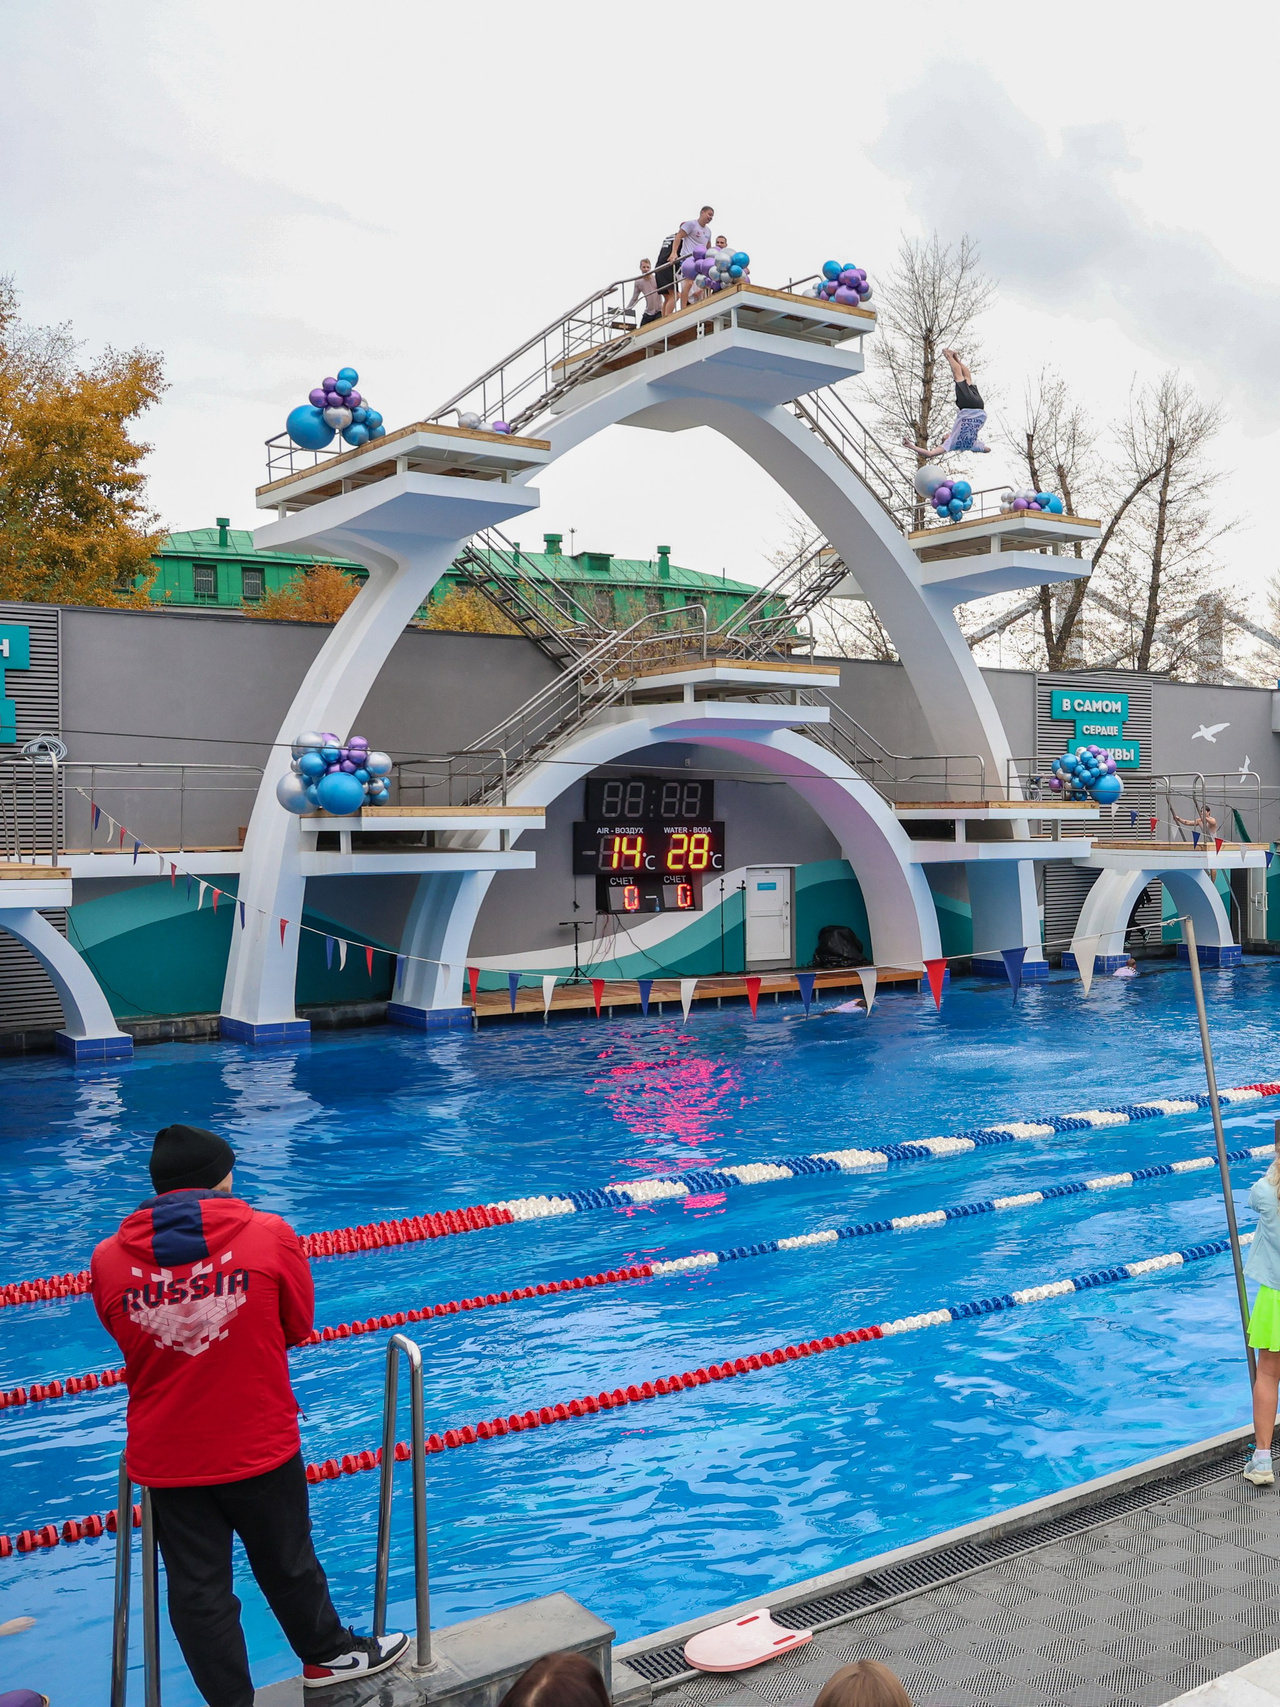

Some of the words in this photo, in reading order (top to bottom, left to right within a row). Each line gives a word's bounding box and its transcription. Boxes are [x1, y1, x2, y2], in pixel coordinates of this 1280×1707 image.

[1062, 698, 1071, 711] В
[1074, 699, 1122, 713] САМОМ
[1082, 725, 1119, 736] СЕРДЦЕ
[1100, 748, 1135, 761] КВЫ
[614, 827, 644, 835] ВОЗДУХ
[663, 826, 688, 834] WATER
[692, 826, 713, 834] ВОДА
[612, 836, 643, 869] 14
[666, 833, 709, 869] 28
[609, 876, 634, 886] СЧЕТ
[663, 875, 687, 884] СЧЕТ
[121, 1268, 249, 1313] RUSSIA
